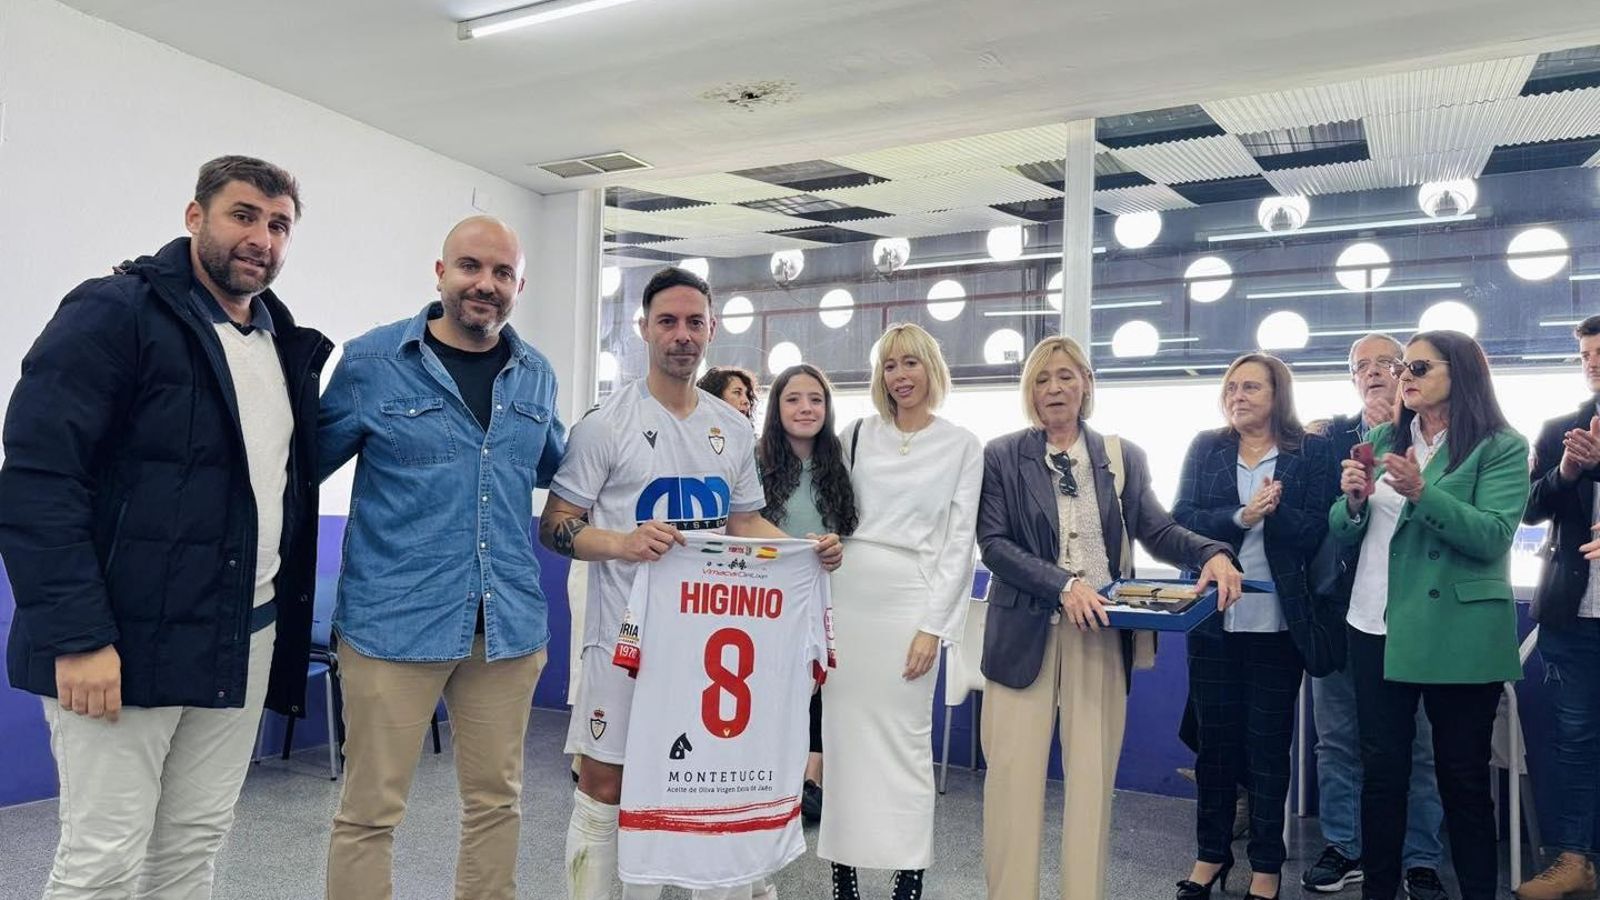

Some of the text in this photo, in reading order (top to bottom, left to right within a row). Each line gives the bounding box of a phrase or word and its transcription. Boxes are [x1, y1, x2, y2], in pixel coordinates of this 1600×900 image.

[680, 581, 783, 619] HIGINIO
[701, 627, 755, 738] 8
[668, 771, 773, 782] MONTETUCCI
